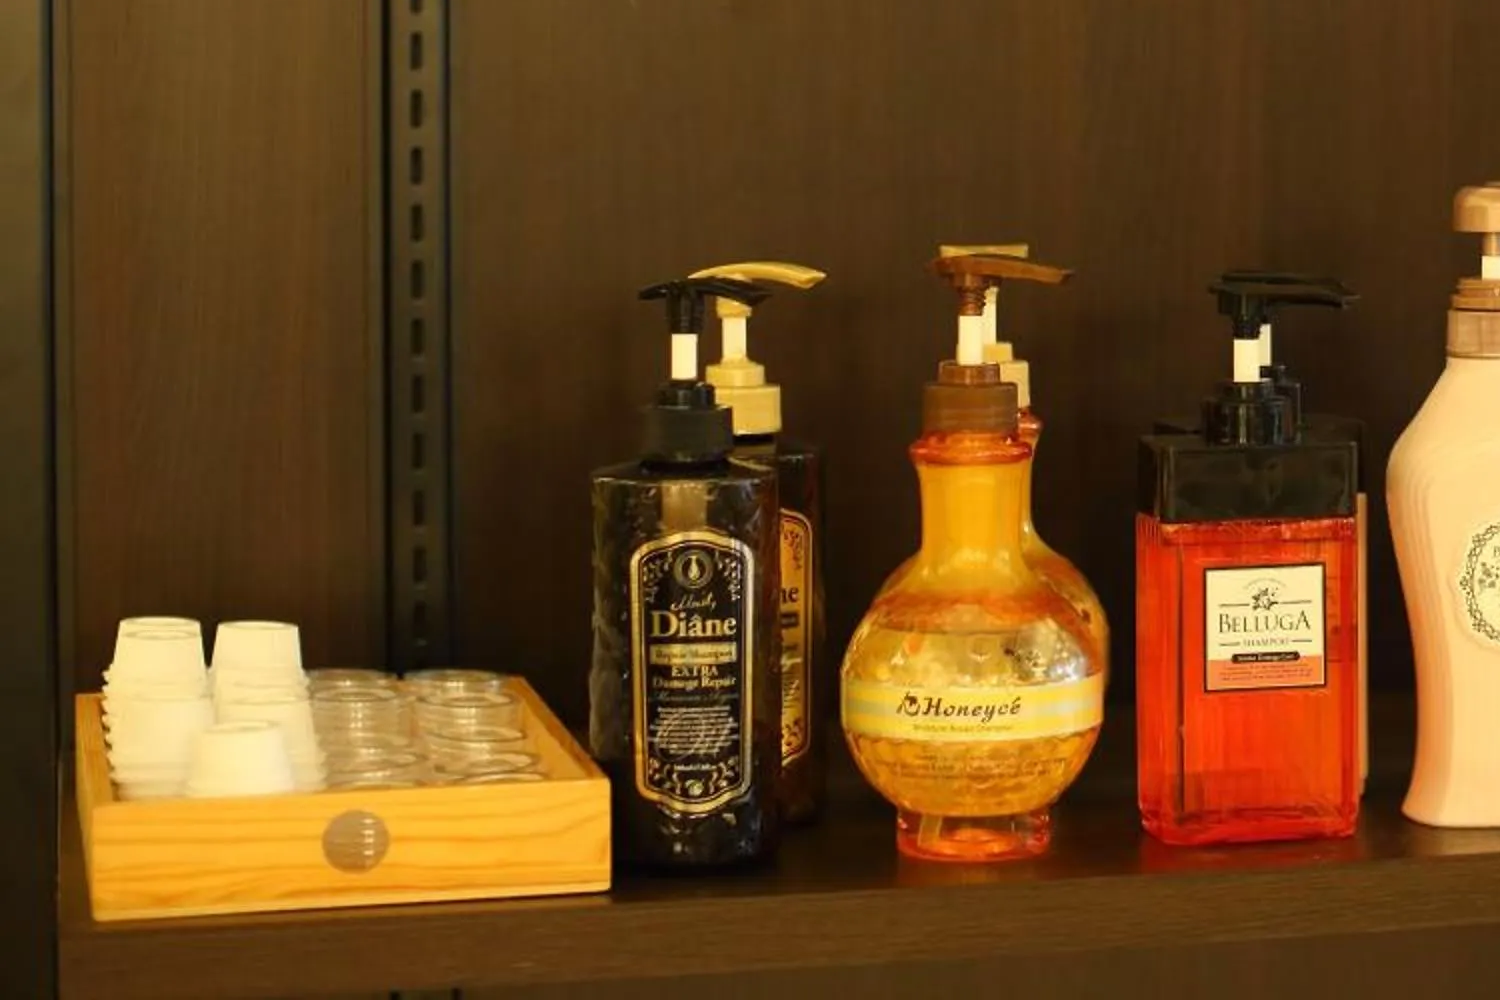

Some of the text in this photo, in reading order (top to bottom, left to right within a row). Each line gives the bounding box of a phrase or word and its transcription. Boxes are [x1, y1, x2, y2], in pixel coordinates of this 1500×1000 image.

[651, 610, 737, 637] Diâne
[1219, 610, 1311, 634] BELUGA
[671, 664, 718, 677] EXTRA
[702, 675, 736, 689] Repair
[922, 695, 1021, 723] Honeycé
